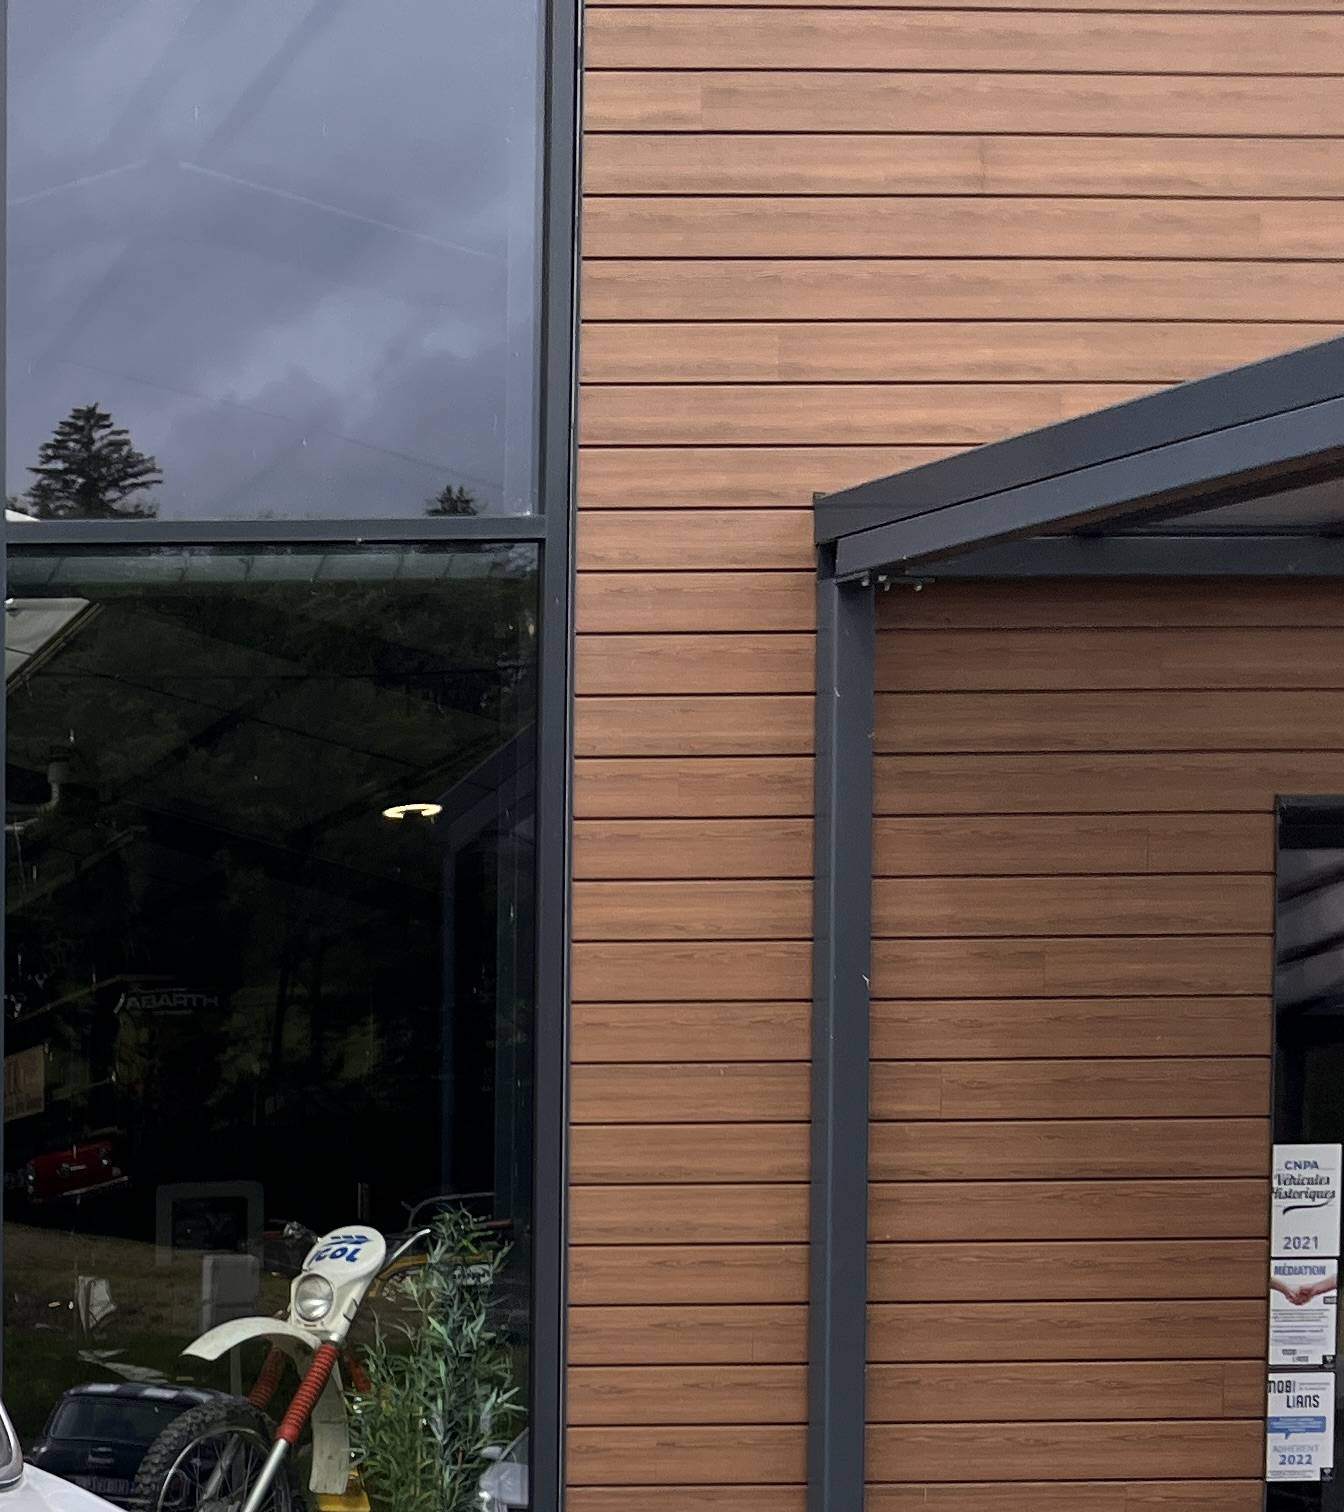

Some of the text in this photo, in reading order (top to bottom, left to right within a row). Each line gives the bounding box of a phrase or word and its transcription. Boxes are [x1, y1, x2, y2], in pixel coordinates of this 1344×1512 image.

[125, 993, 220, 1009] ABARTH
[1284, 1160, 1319, 1170] CNPA
[1283, 1236, 1318, 1250] 2021
[1279, 1454, 1312, 1465] 2022
